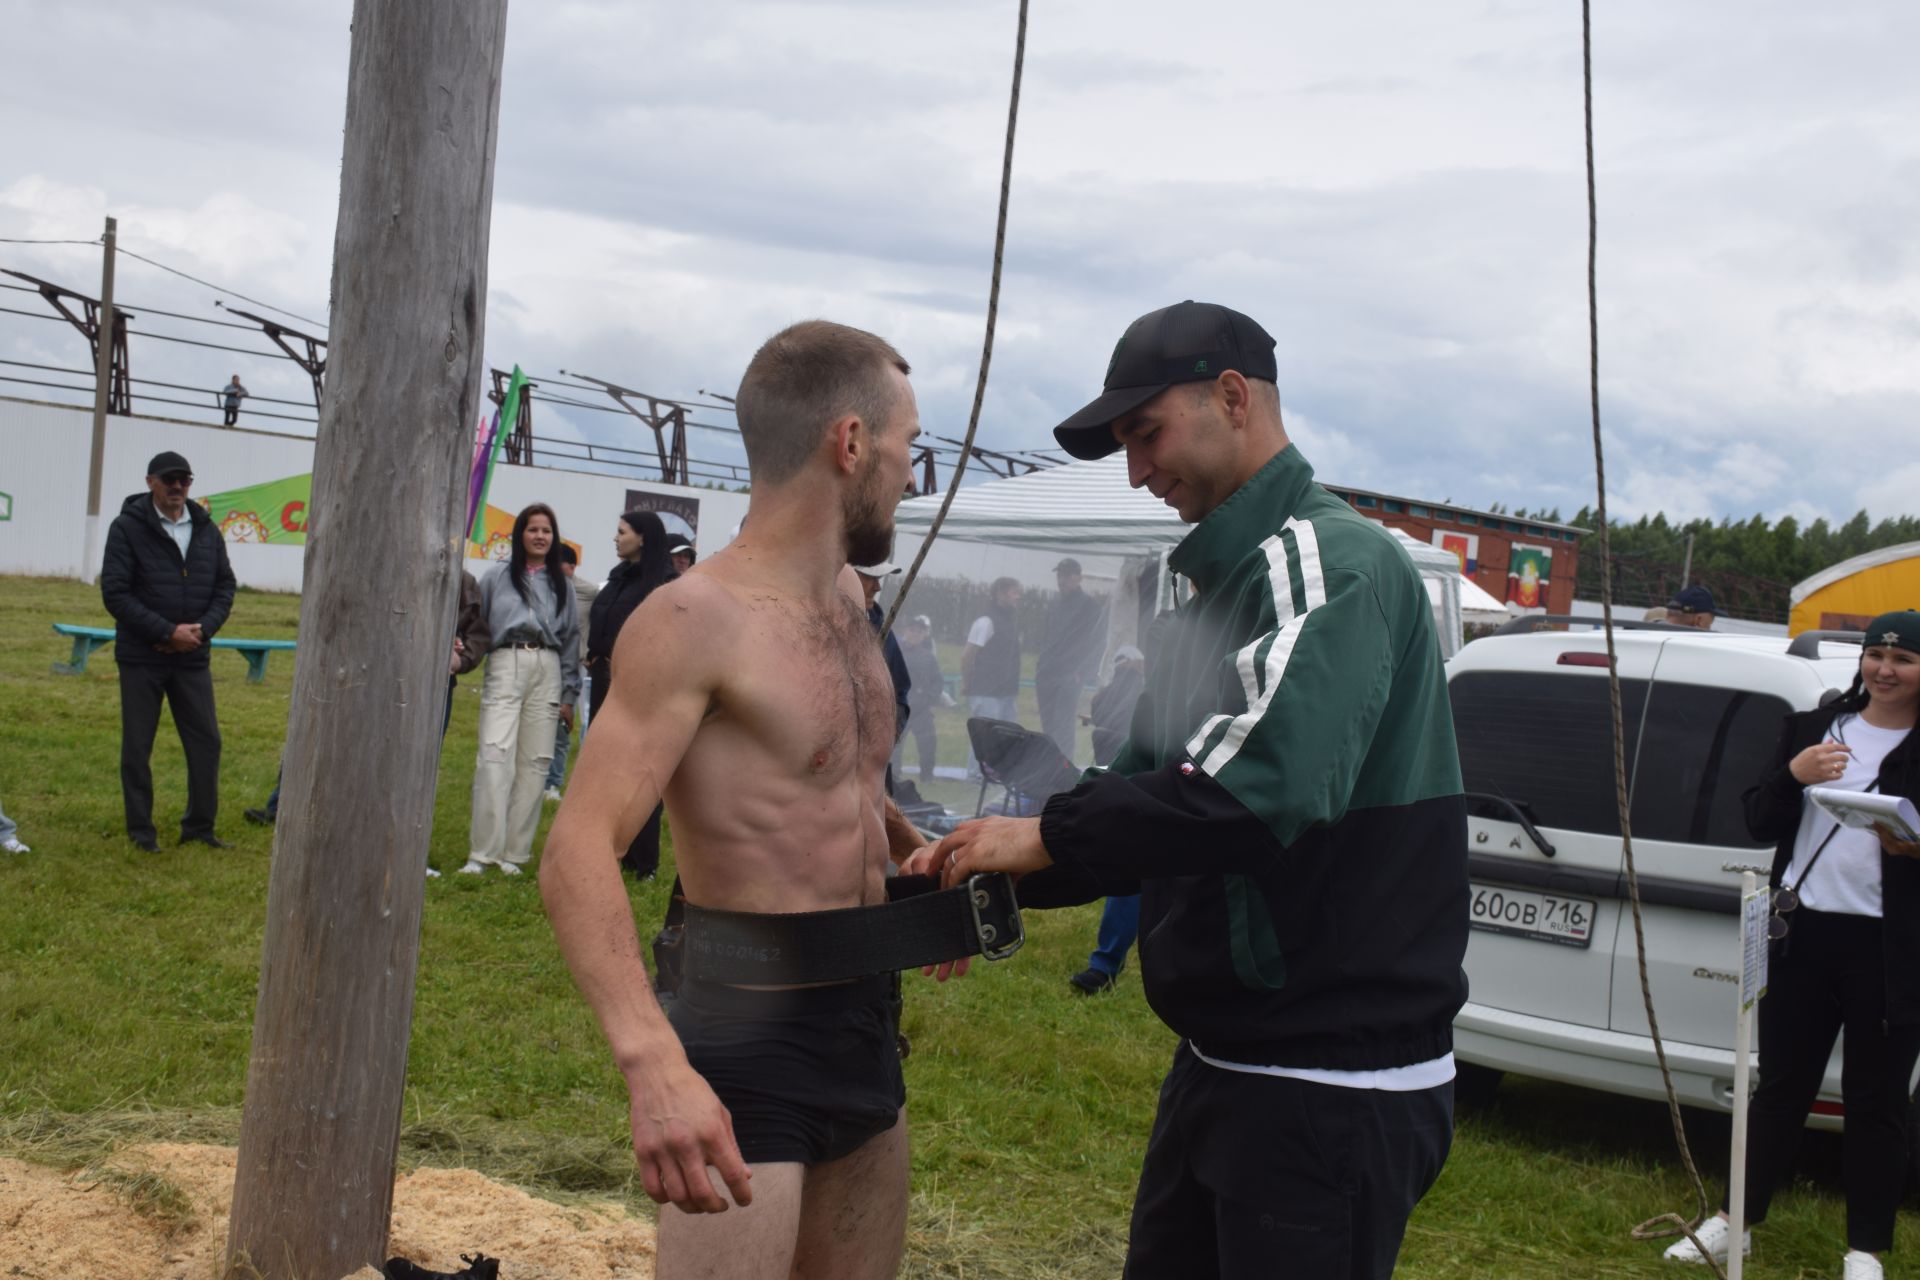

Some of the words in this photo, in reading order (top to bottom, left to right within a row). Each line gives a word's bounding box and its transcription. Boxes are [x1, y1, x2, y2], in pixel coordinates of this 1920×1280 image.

[1476, 832, 1521, 848] DA
[1472, 890, 1537, 925] 60ОВ
[1545, 899, 1582, 925] 716
[1550, 921, 1570, 932] RUS
